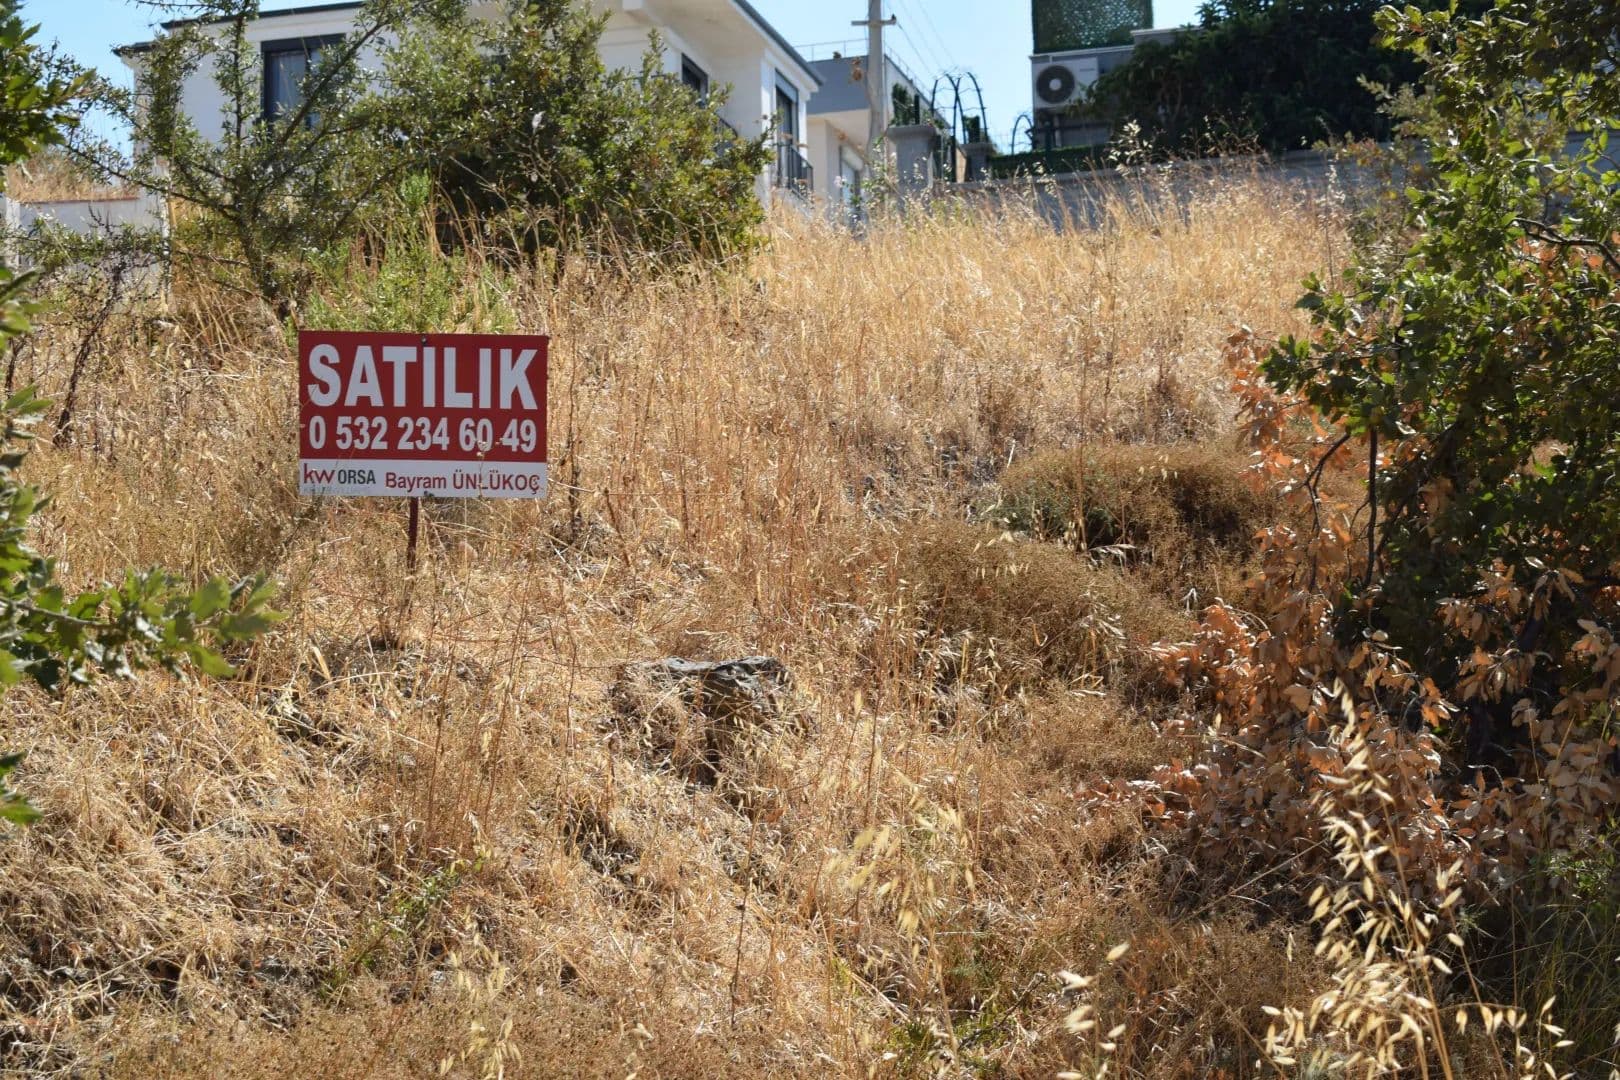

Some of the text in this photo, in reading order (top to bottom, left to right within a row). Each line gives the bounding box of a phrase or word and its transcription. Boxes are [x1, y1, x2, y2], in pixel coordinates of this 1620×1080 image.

[307, 344, 538, 410] SATILIK
[309, 415, 537, 453] 0 532 234 60 49
[303, 463, 376, 484] kw ORSA
[385, 472, 447, 492] Bayram
